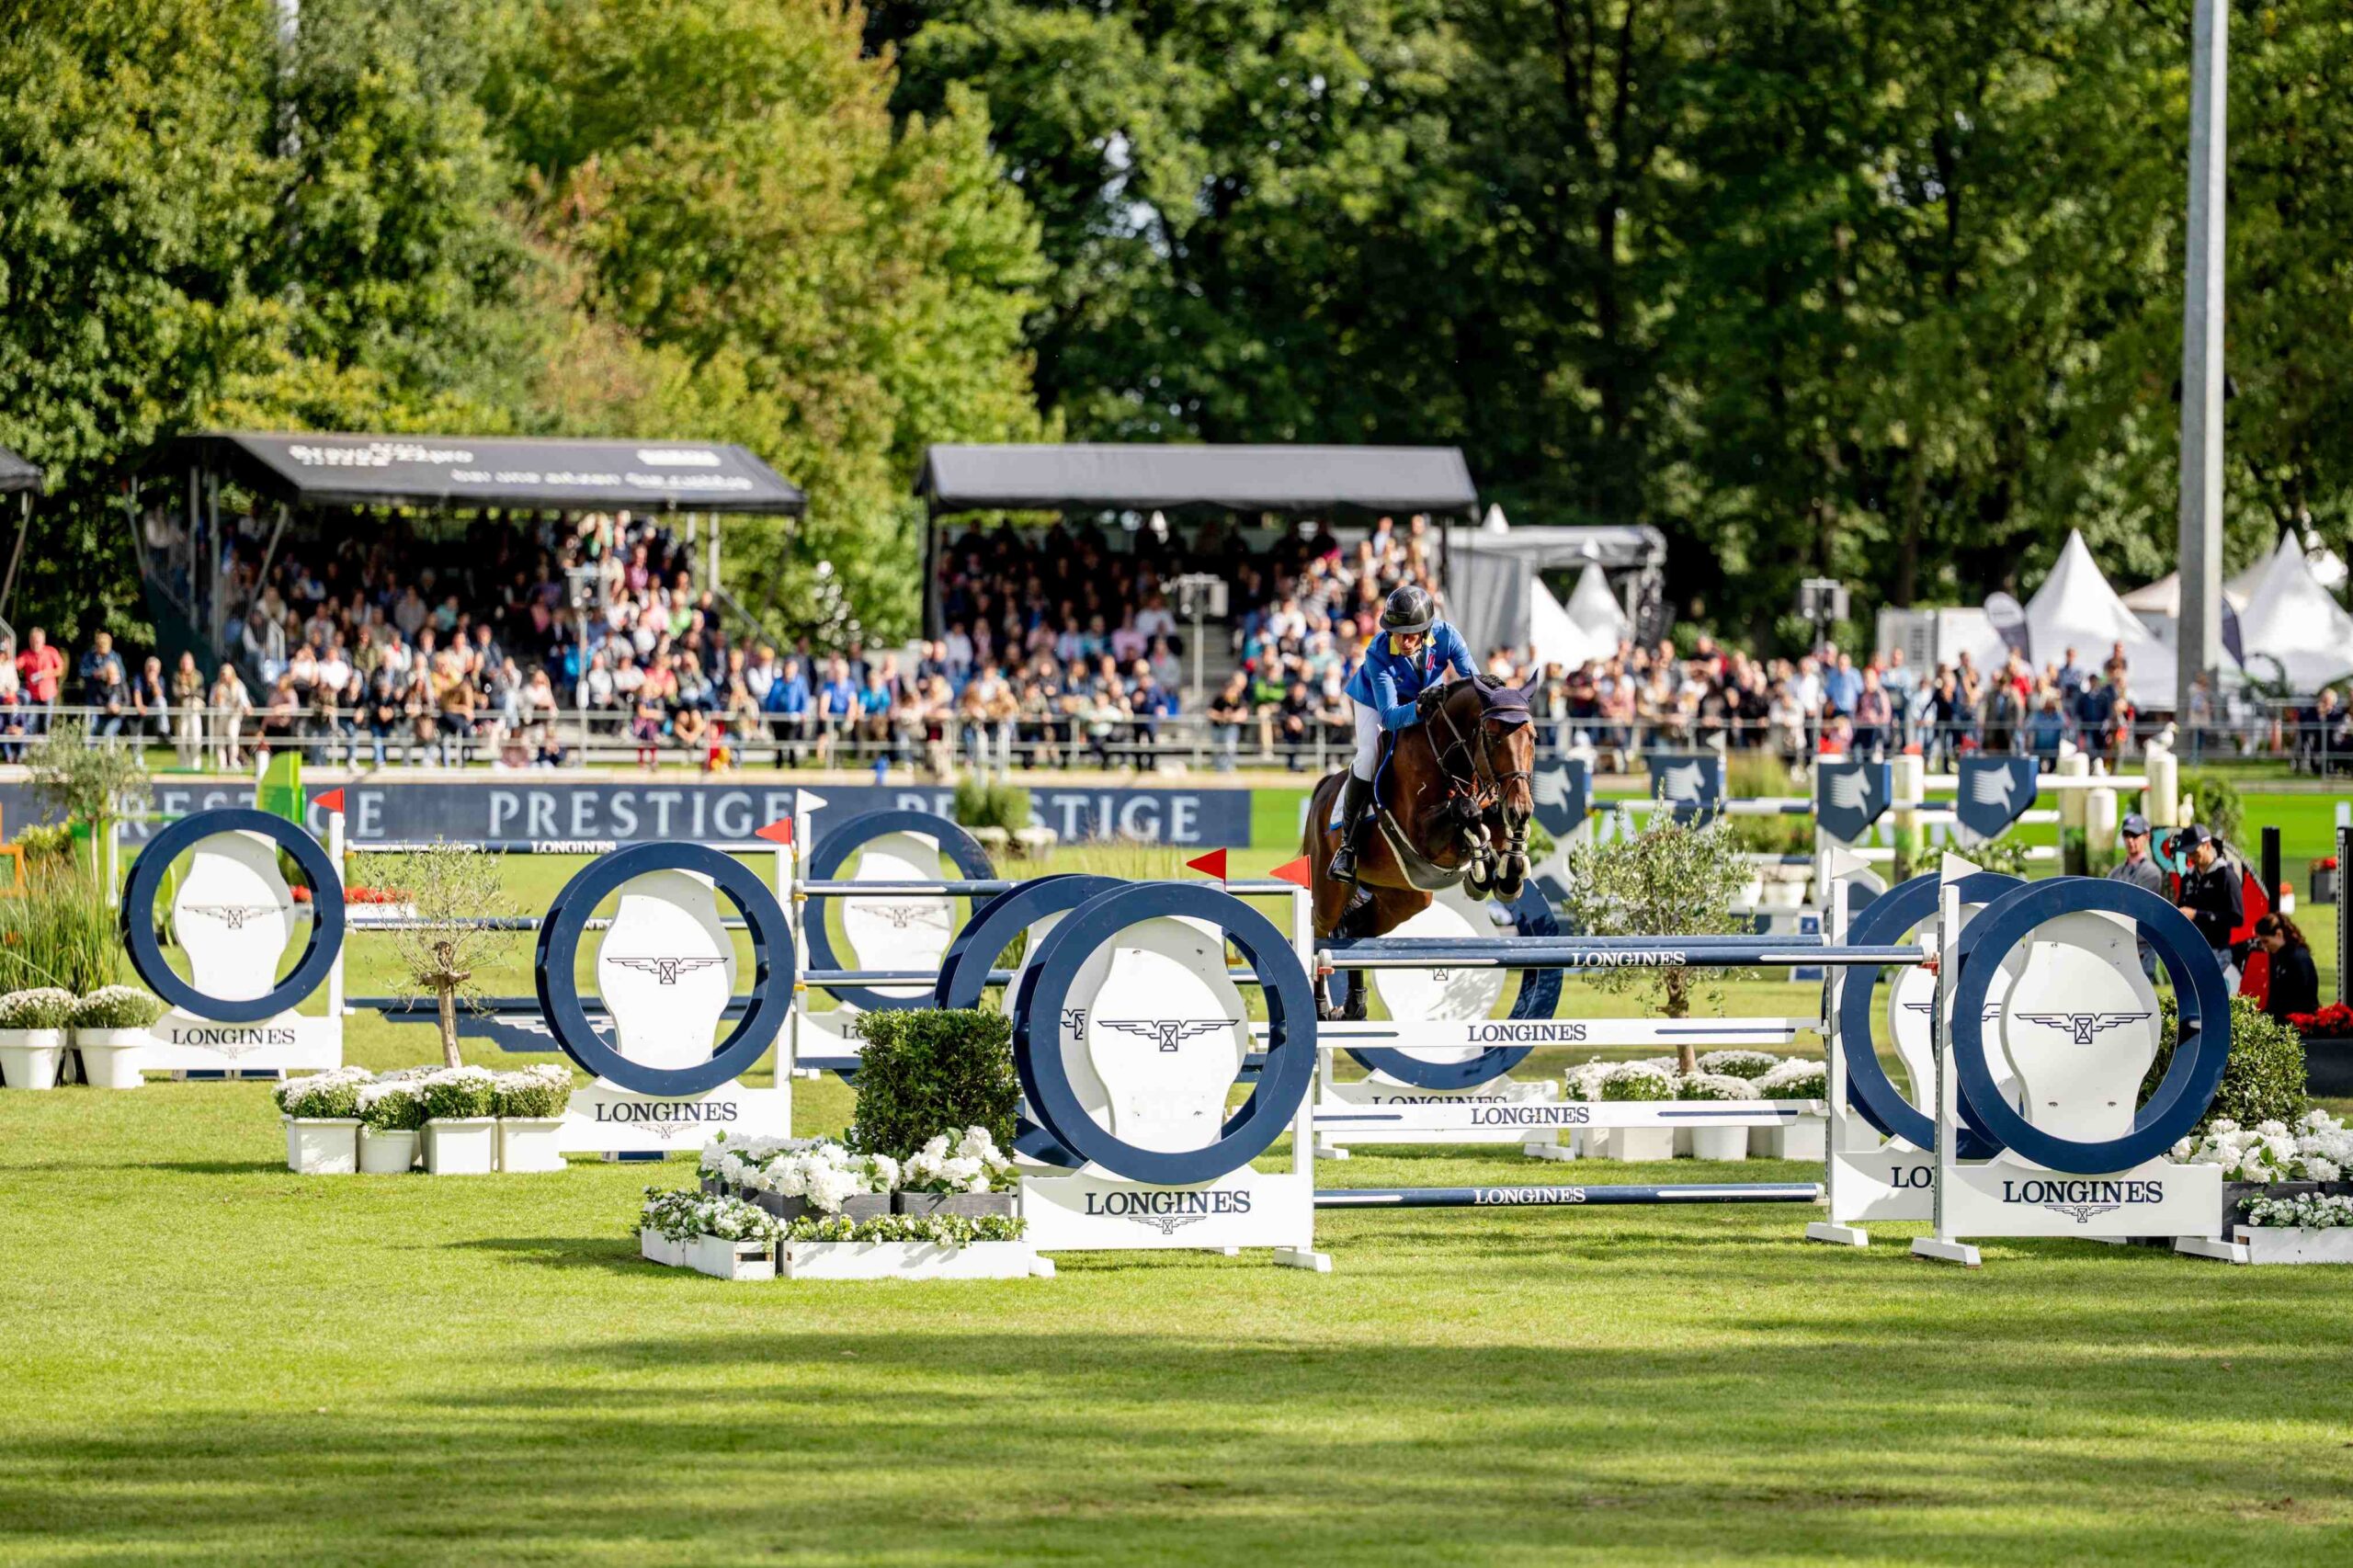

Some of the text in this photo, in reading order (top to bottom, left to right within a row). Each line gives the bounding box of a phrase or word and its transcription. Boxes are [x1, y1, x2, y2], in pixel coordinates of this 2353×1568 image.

[487, 790, 794, 838] PRESTIGE
[531, 839, 617, 854] LONGINES
[1572, 950, 1687, 968] LONGINES
[172, 1028, 296, 1045] LONGINES
[1467, 1024, 1586, 1042] LONGINES
[595, 1101, 738, 1123] LONGINES
[1471, 1107, 1590, 1125] LONGINES
[1473, 1187, 1586, 1205] LONGINES
[2002, 1179, 2164, 1204] LONGINES
[1085, 1190, 1252, 1216] LONGINES
